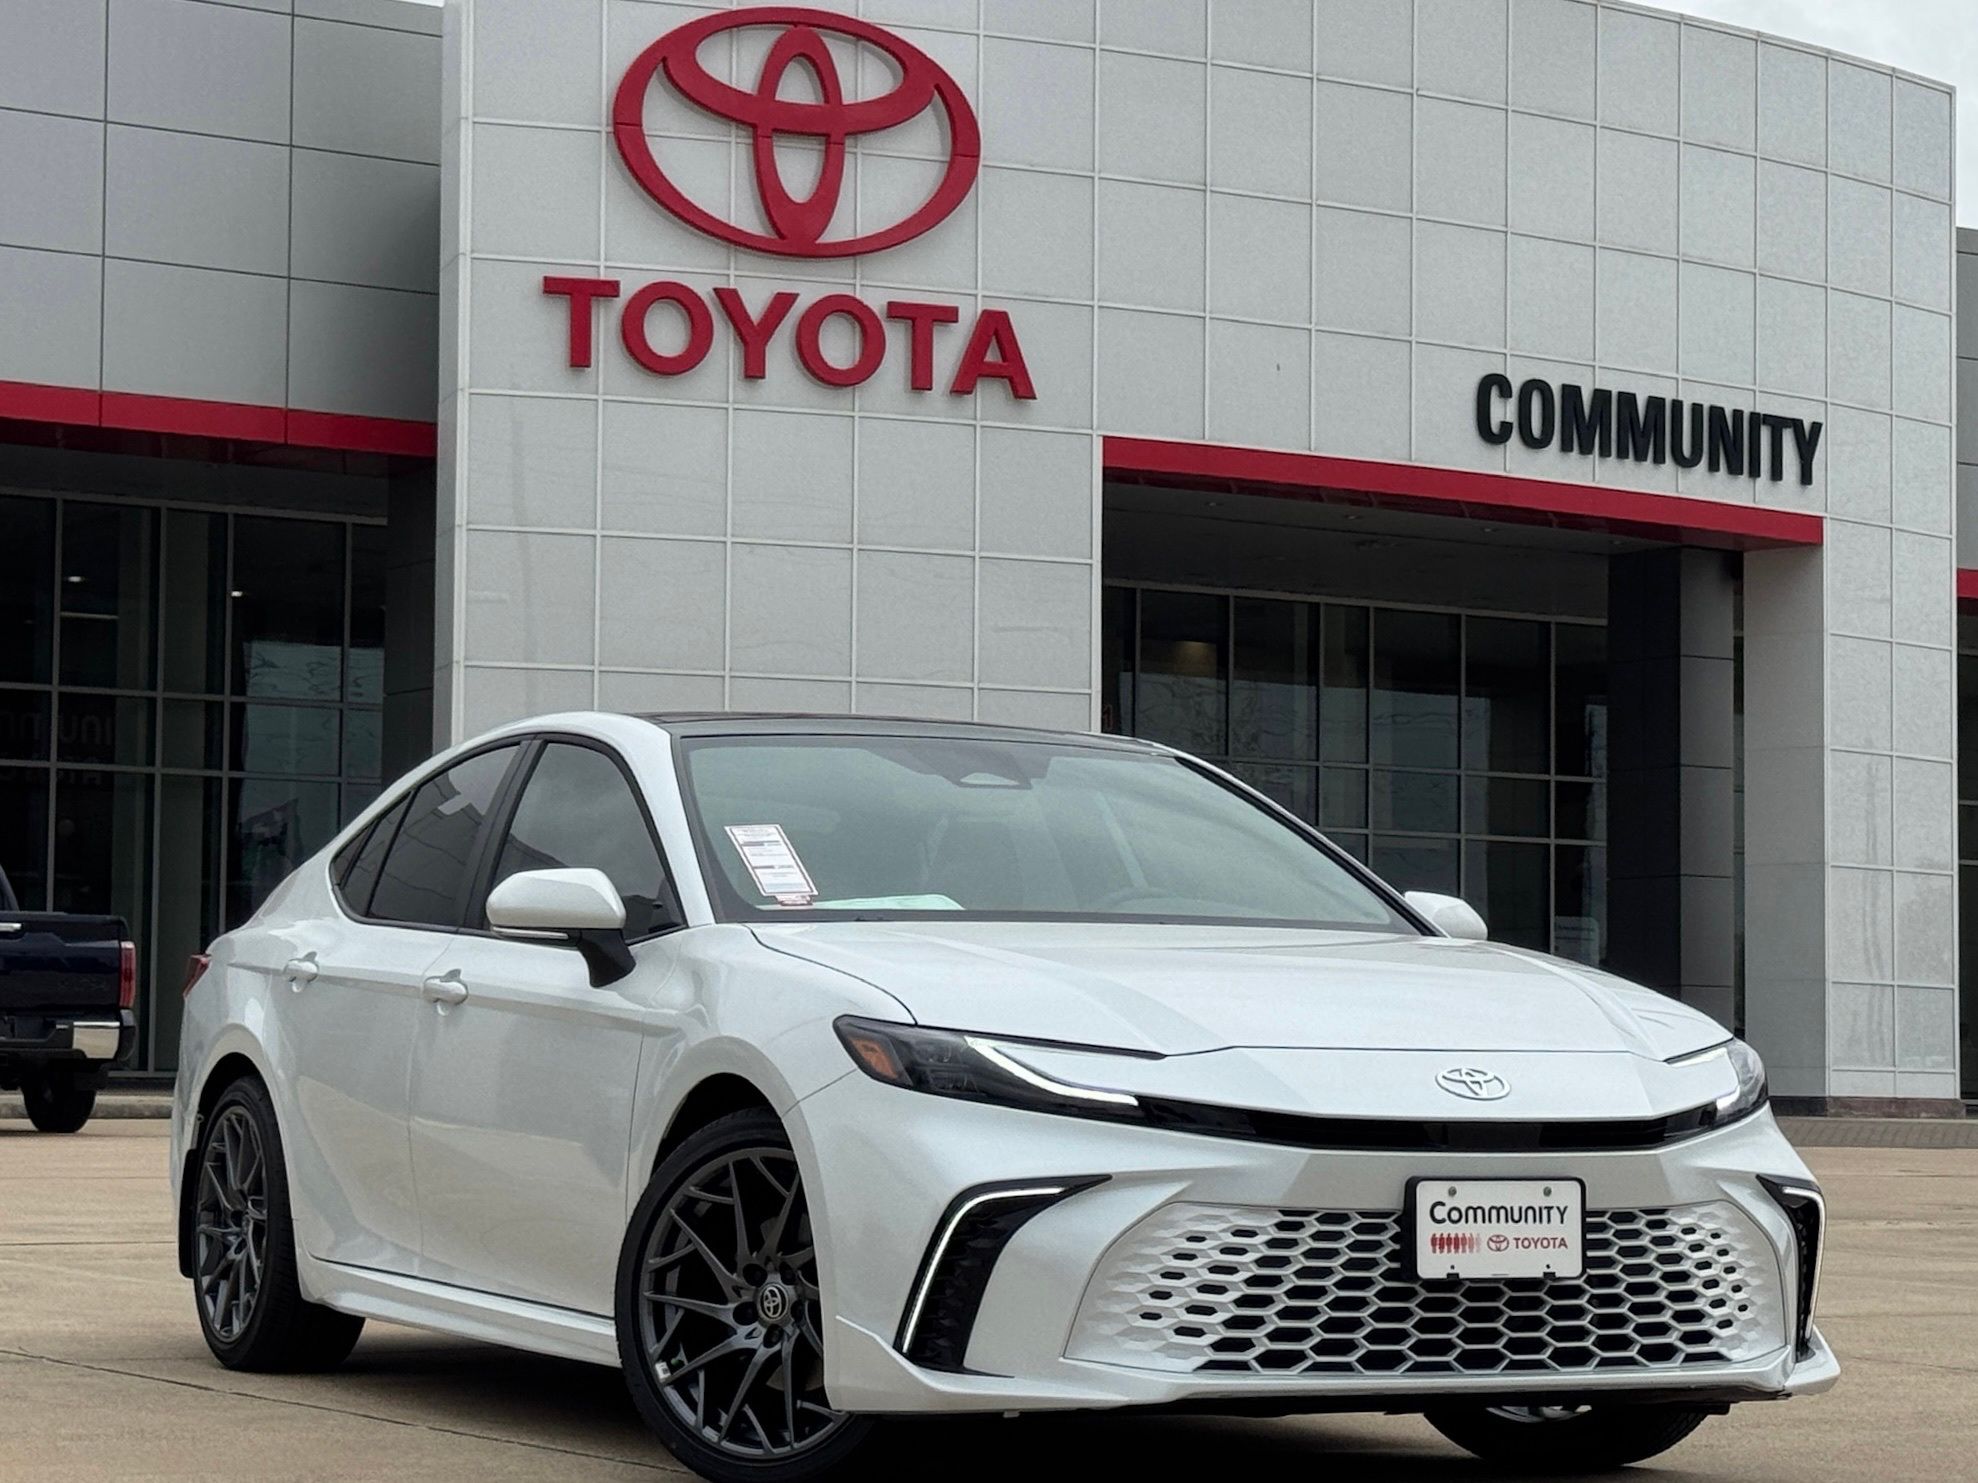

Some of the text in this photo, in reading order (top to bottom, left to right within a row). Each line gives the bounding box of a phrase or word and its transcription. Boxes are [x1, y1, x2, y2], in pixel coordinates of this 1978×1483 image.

[543, 275, 1037, 401] TOYOTA
[1476, 373, 1824, 486] COMMUNITY
[1513, 1237, 1569, 1250] TOYOTA
